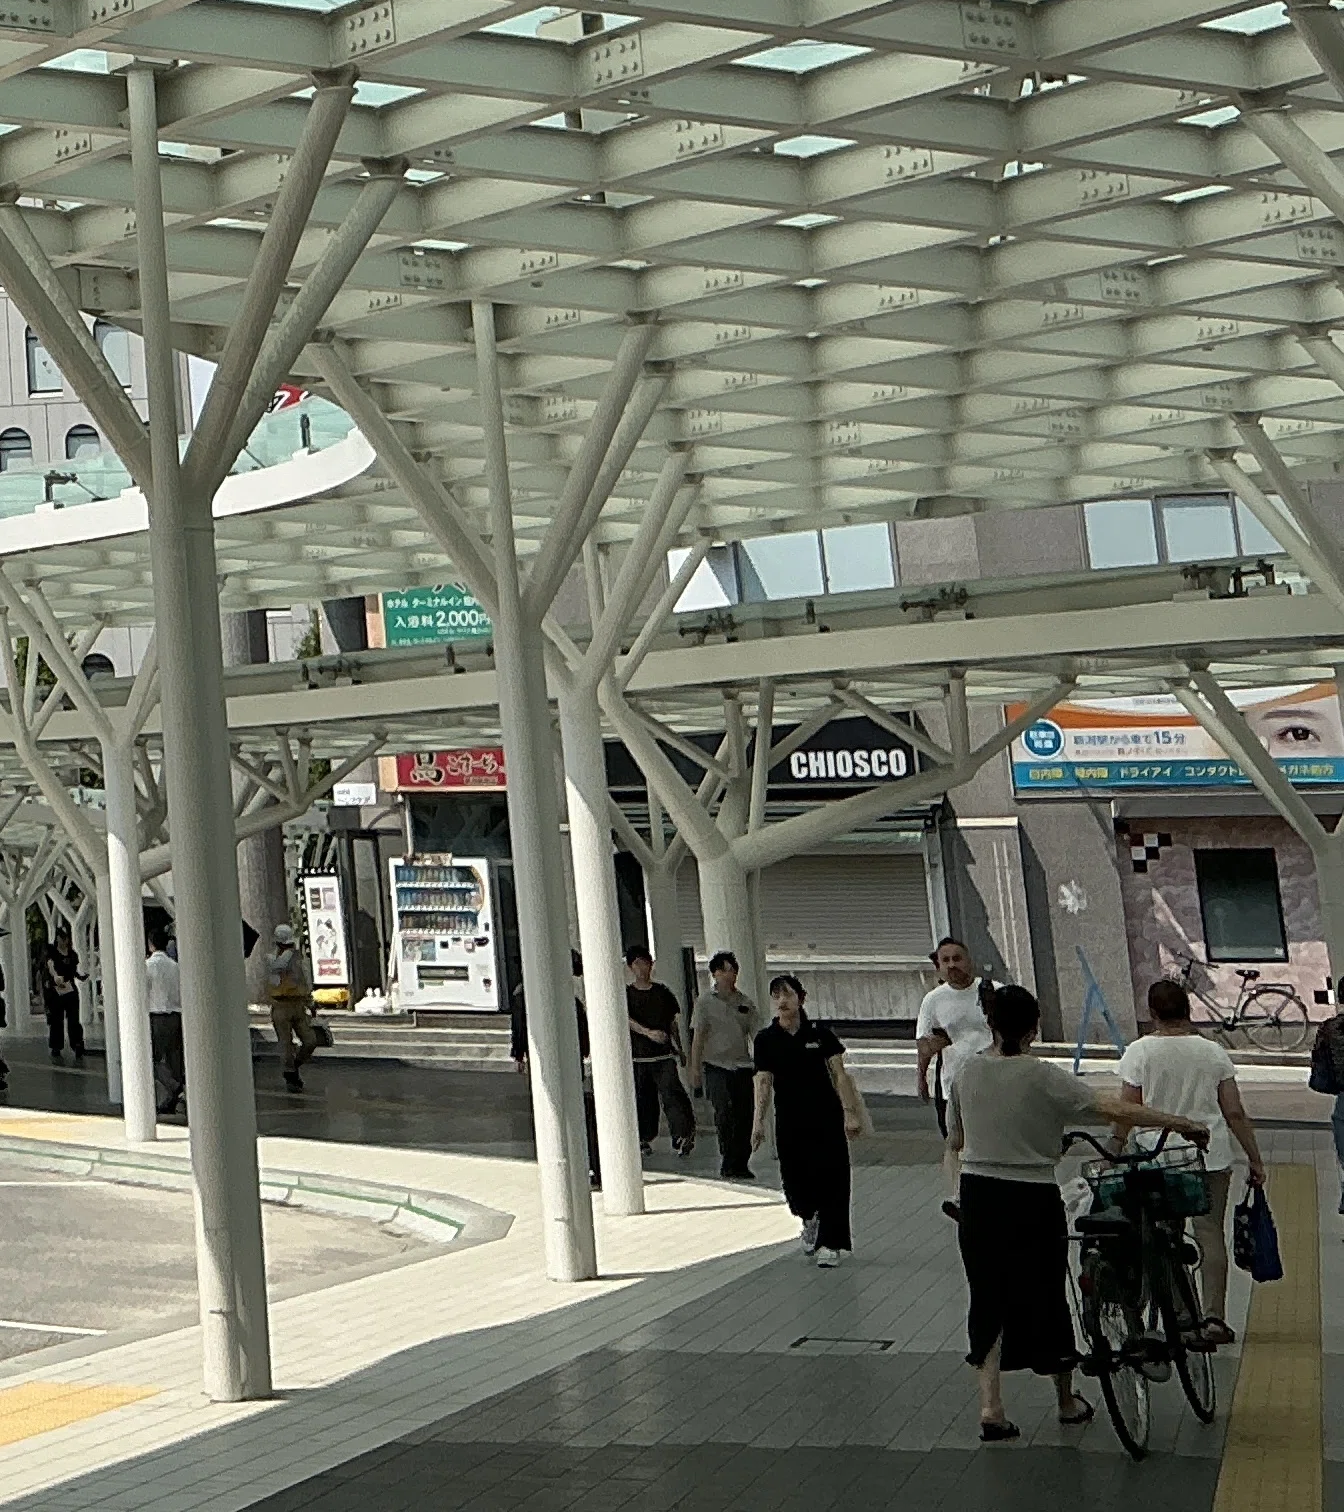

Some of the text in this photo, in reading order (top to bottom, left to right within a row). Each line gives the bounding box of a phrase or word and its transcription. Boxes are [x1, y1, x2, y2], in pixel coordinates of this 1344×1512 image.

[790, 748, 907, 779] CHIOSCO
[1119, 766, 1172, 779] ドライアイ
